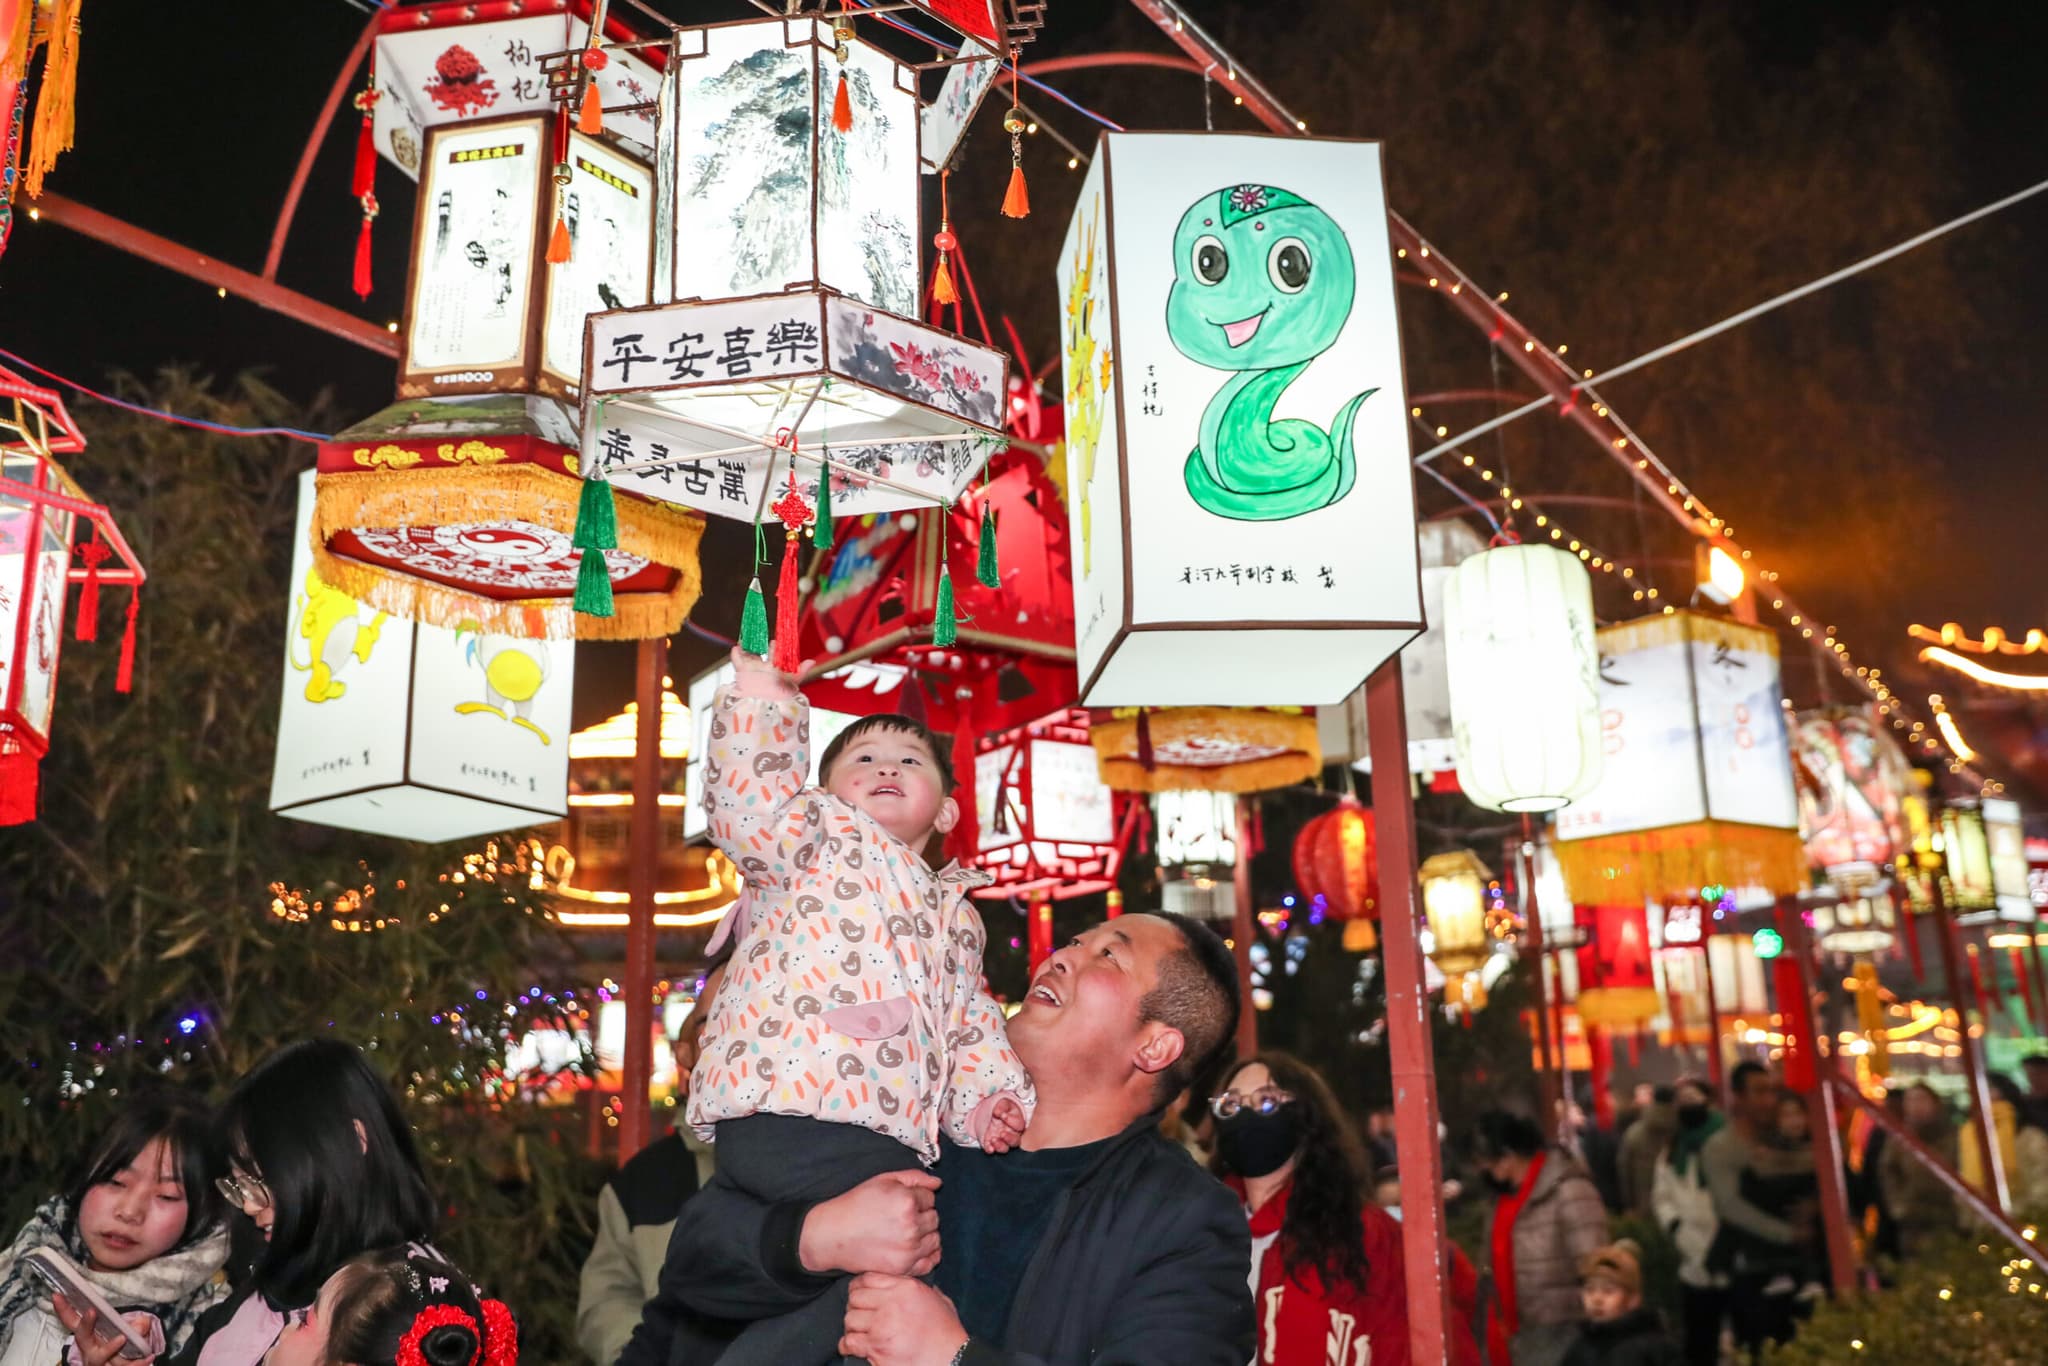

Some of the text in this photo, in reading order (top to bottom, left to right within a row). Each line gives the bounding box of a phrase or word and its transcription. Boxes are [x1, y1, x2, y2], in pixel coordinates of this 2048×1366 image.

[504, 40, 539, 104] 枸杞
[602, 318, 819, 383] 平安喜樂
